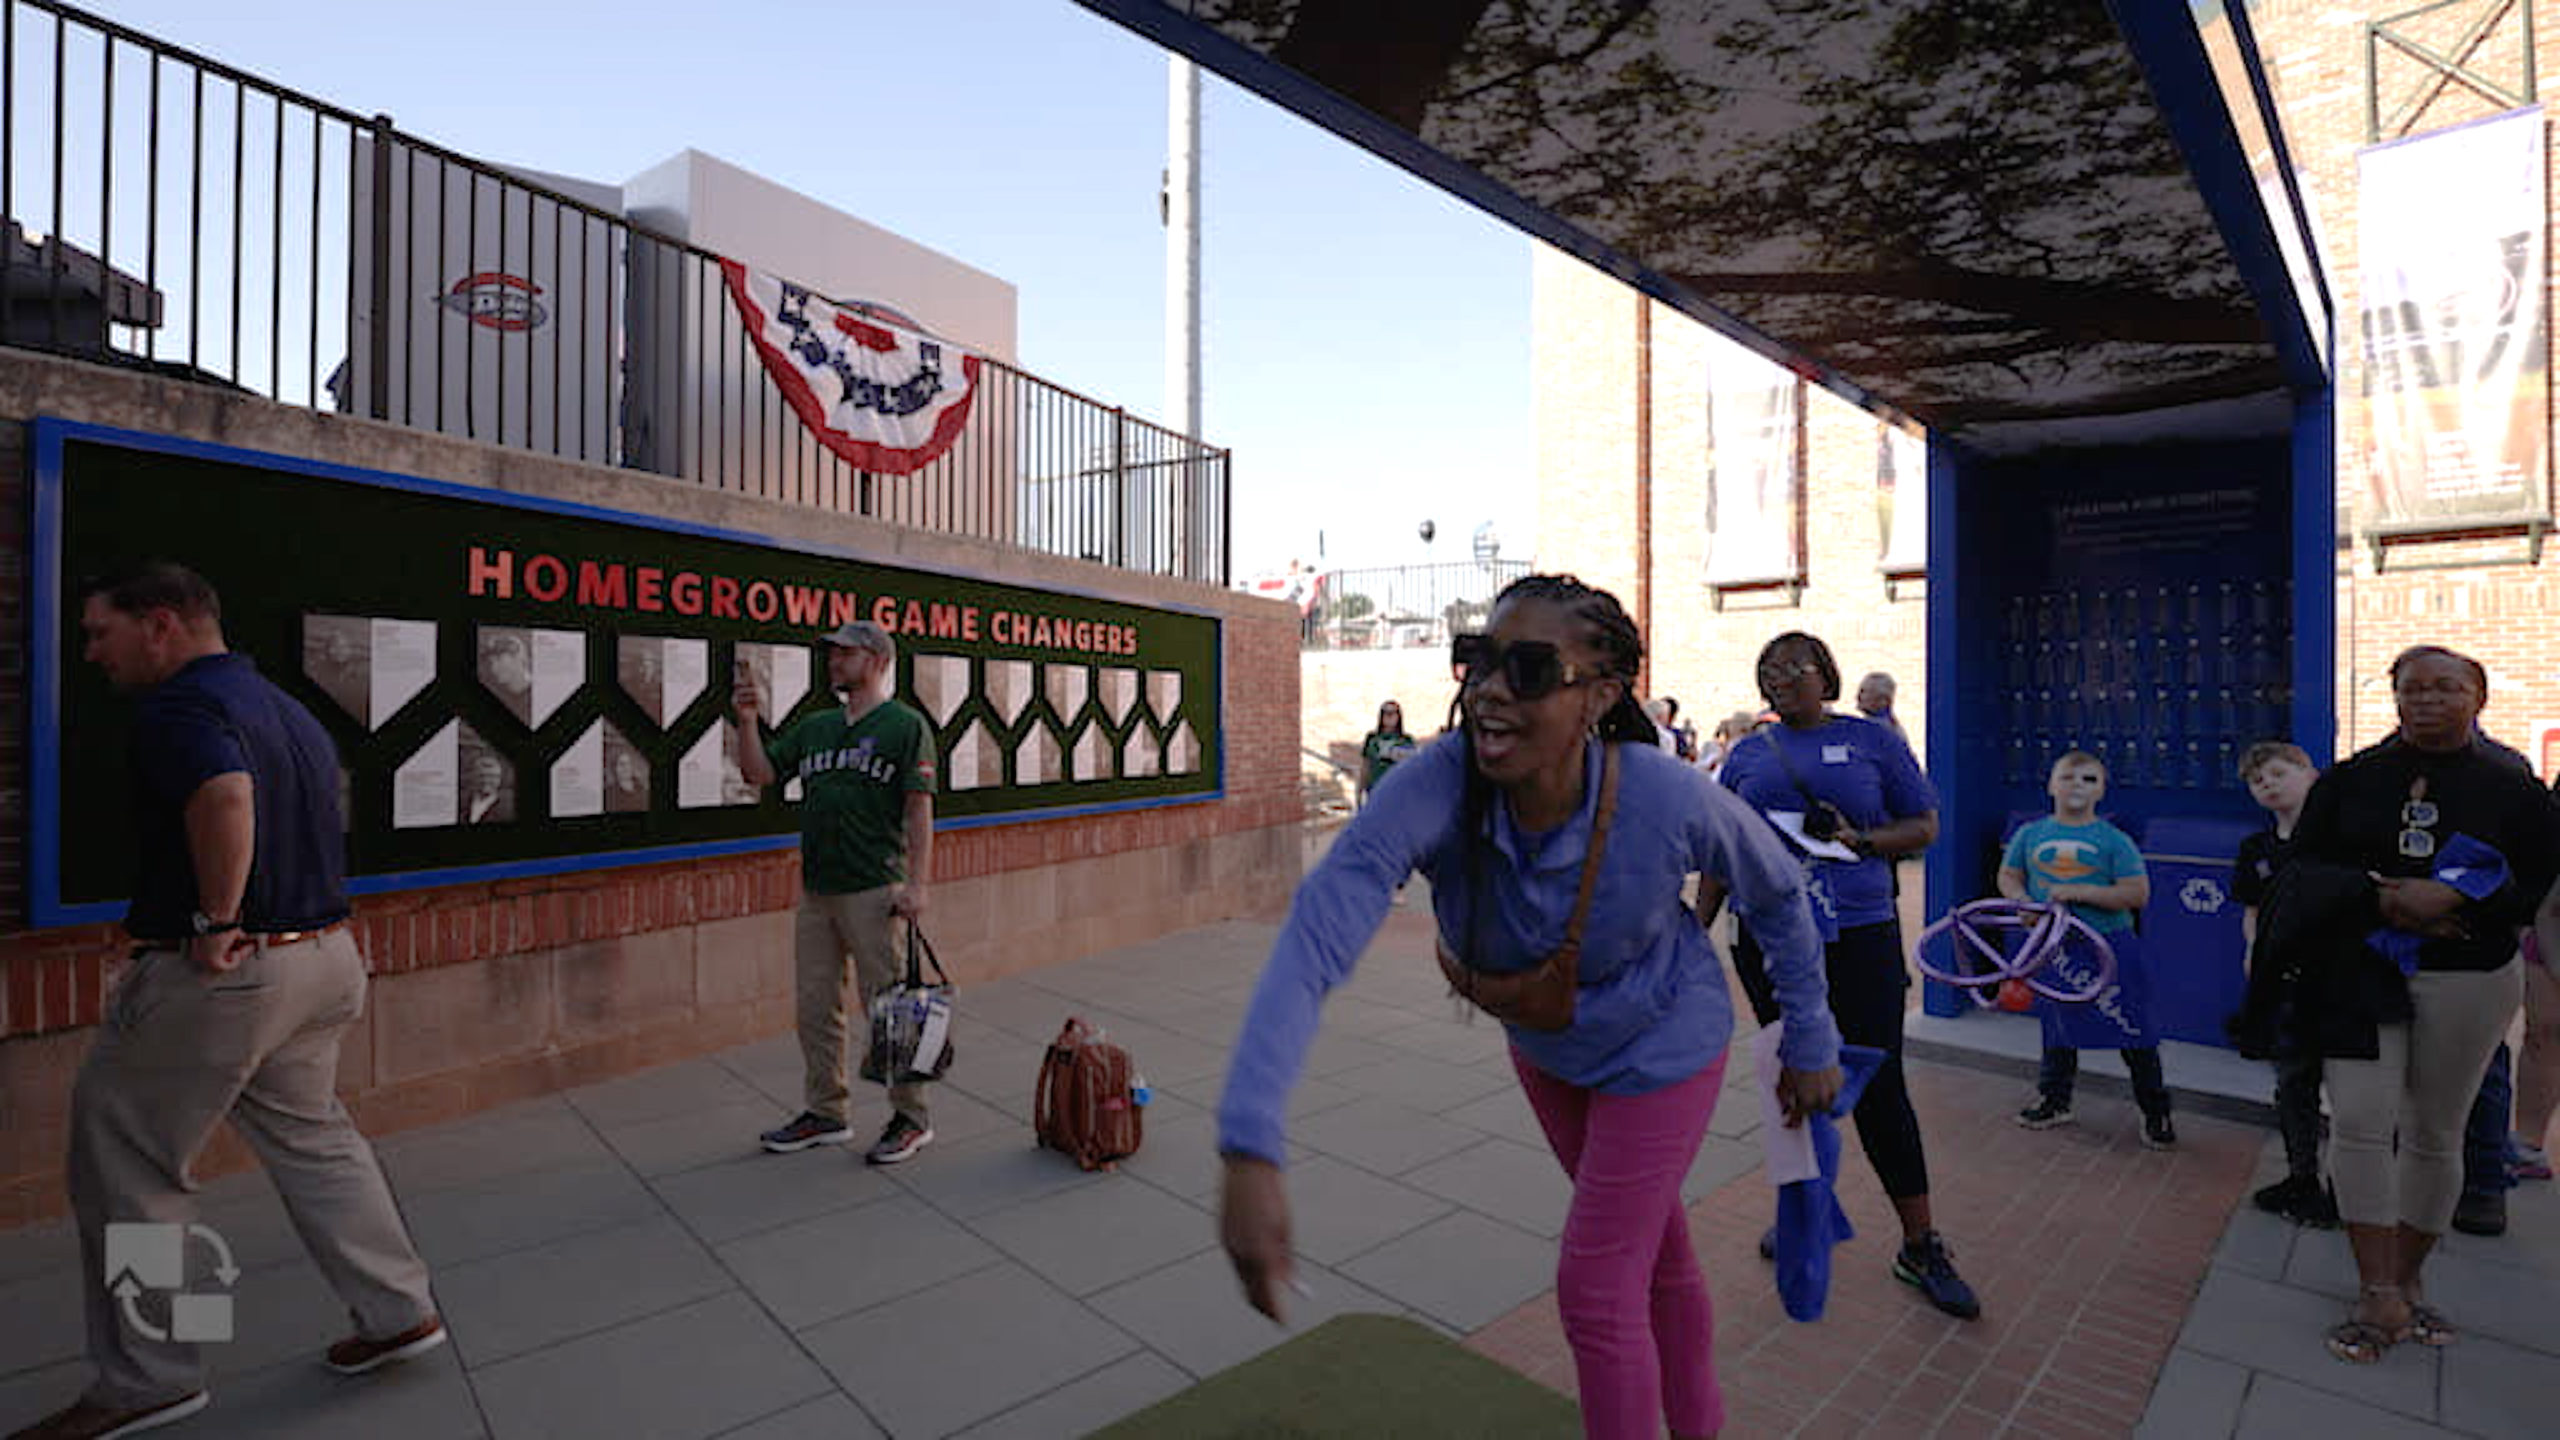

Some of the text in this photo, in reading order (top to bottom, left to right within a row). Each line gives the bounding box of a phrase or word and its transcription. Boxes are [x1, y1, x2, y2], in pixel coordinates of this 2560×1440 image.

[468, 547, 1138, 655] HOMEGROWN GAME CHANGERS
